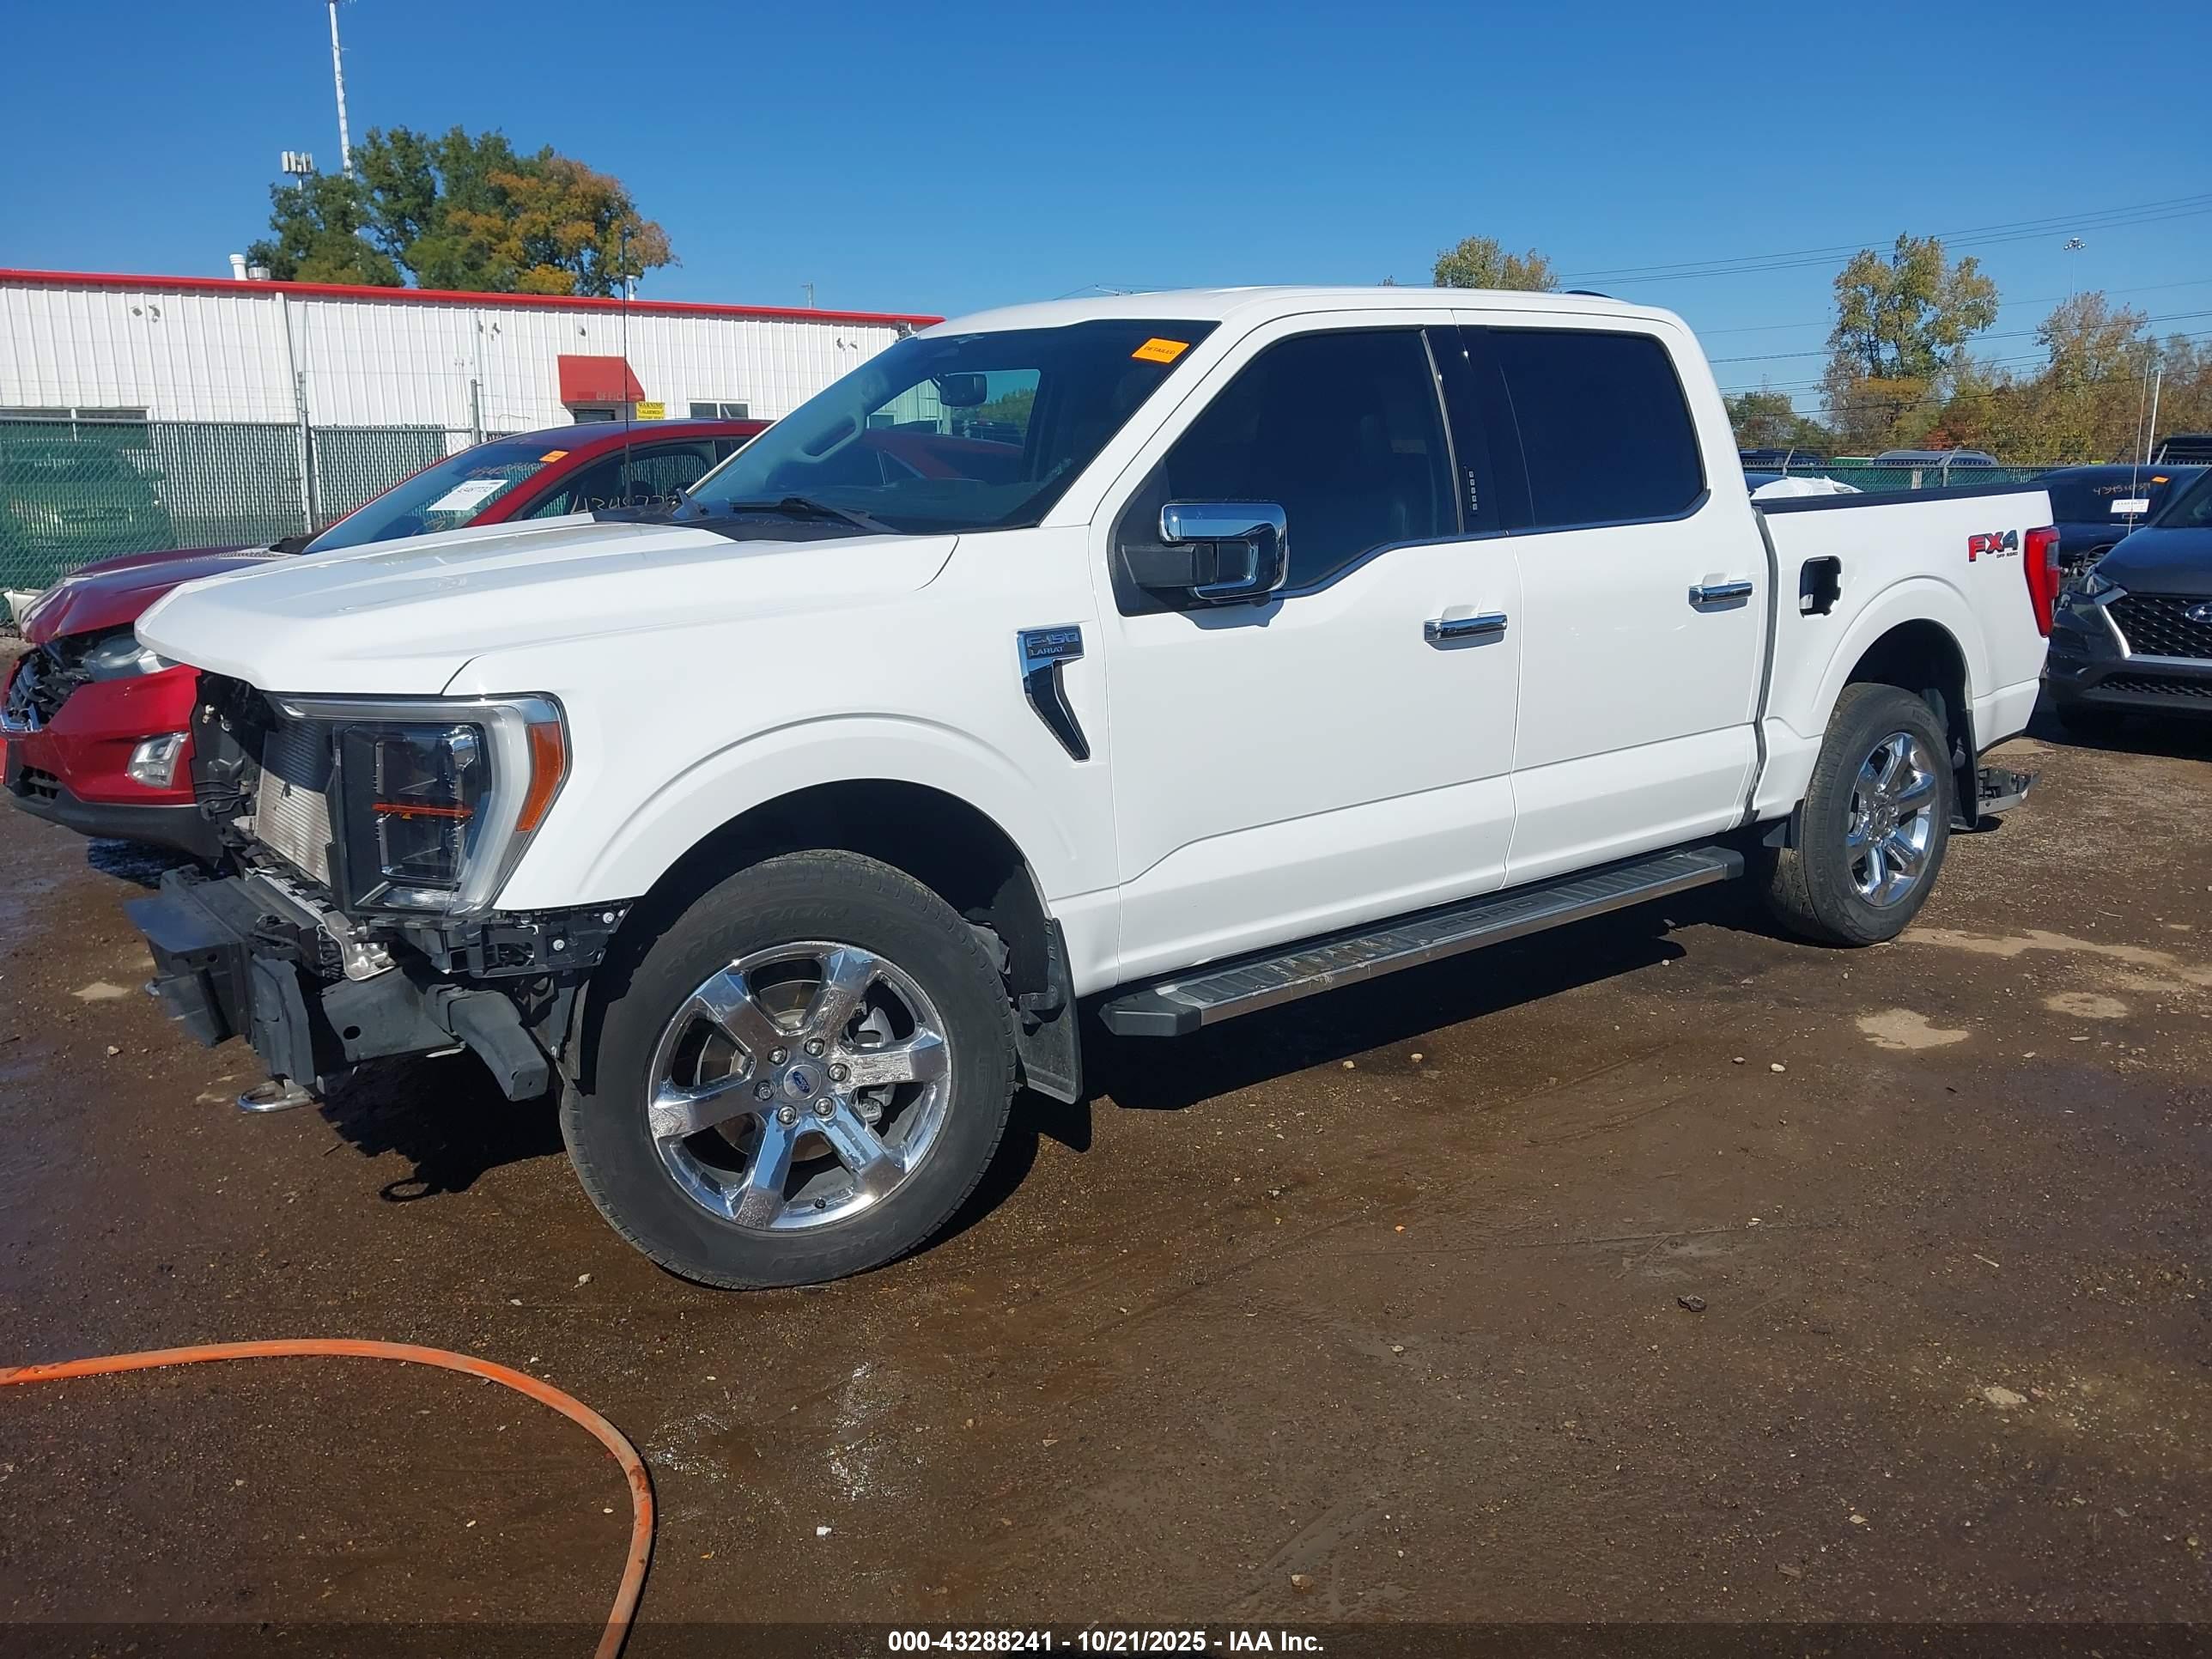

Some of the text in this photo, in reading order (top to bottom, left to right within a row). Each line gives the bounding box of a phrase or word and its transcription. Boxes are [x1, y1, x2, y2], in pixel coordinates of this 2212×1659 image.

[1968, 529, 2019, 562] FX4
[1026, 632, 1079, 647] F-150
[1030, 646, 1065, 656] LARIAT
